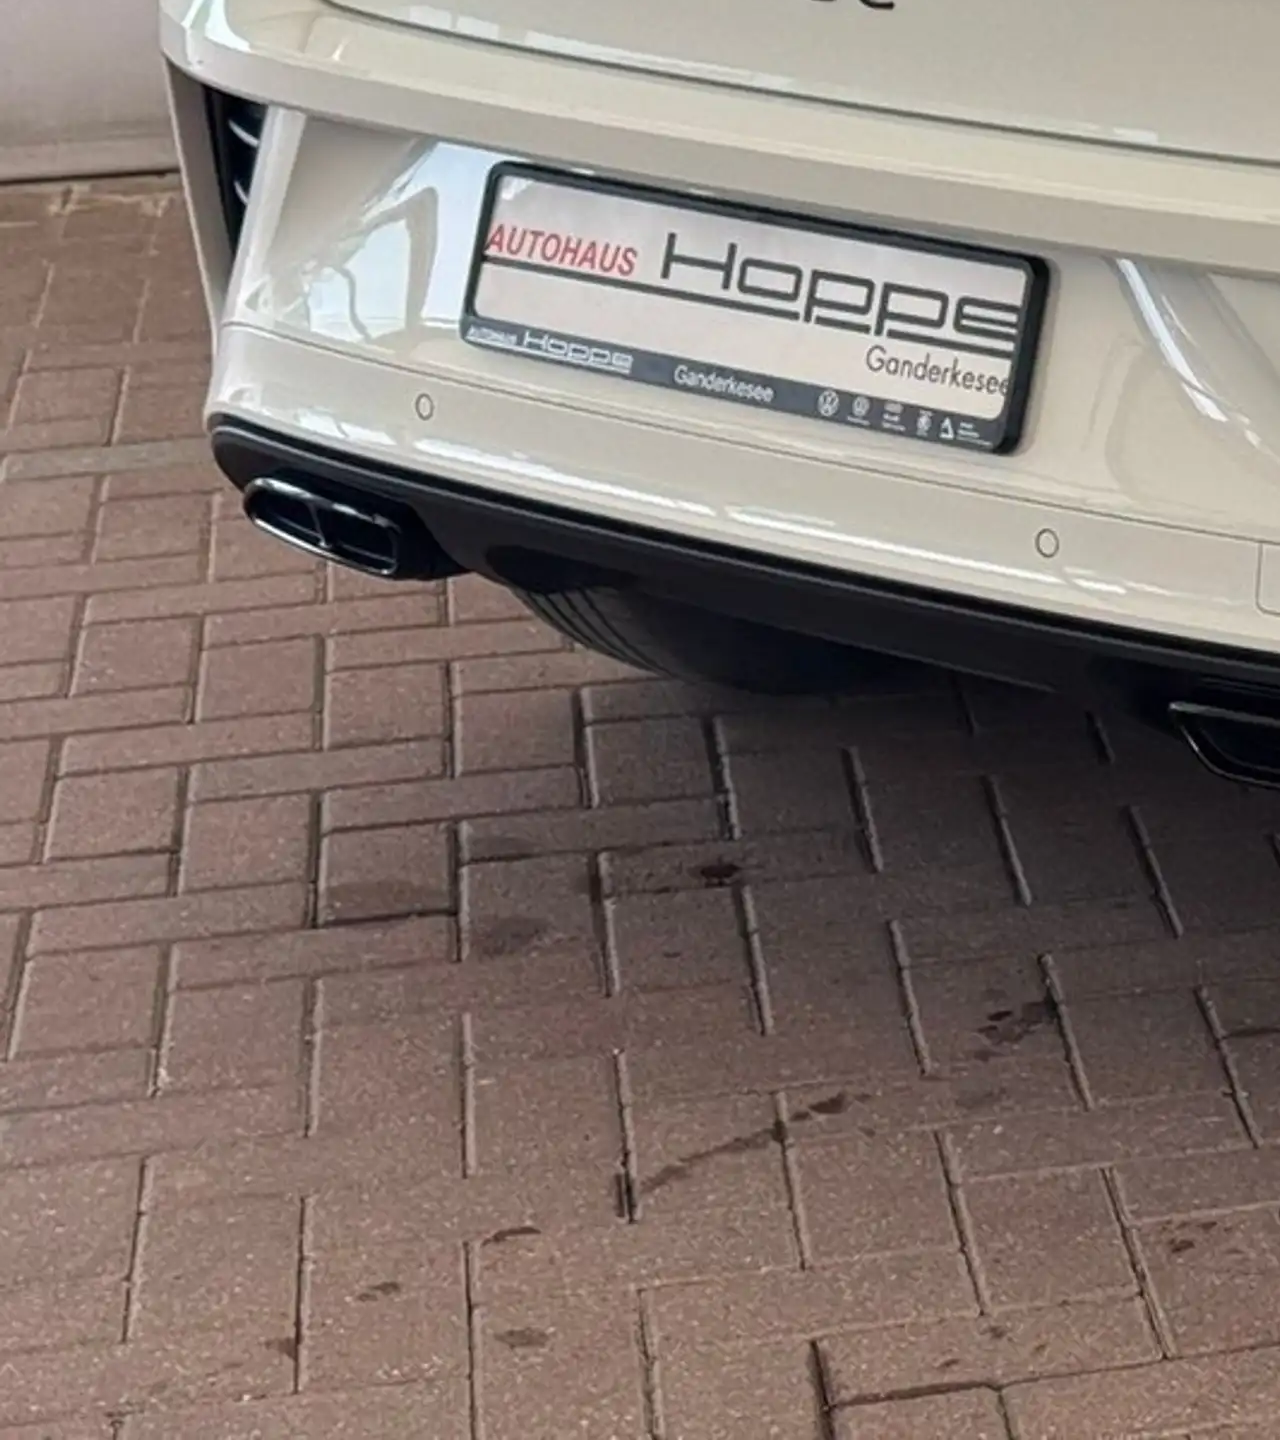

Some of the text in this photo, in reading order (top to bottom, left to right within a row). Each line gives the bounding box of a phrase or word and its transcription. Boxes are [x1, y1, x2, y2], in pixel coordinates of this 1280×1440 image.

[485, 223, 1019, 342] AUTOHAUS Hoppe
[523, 330, 633, 370] Hoppe
[674, 365, 775, 402] Ganderkesee
[866, 344, 1010, 395] Ganderkesee
